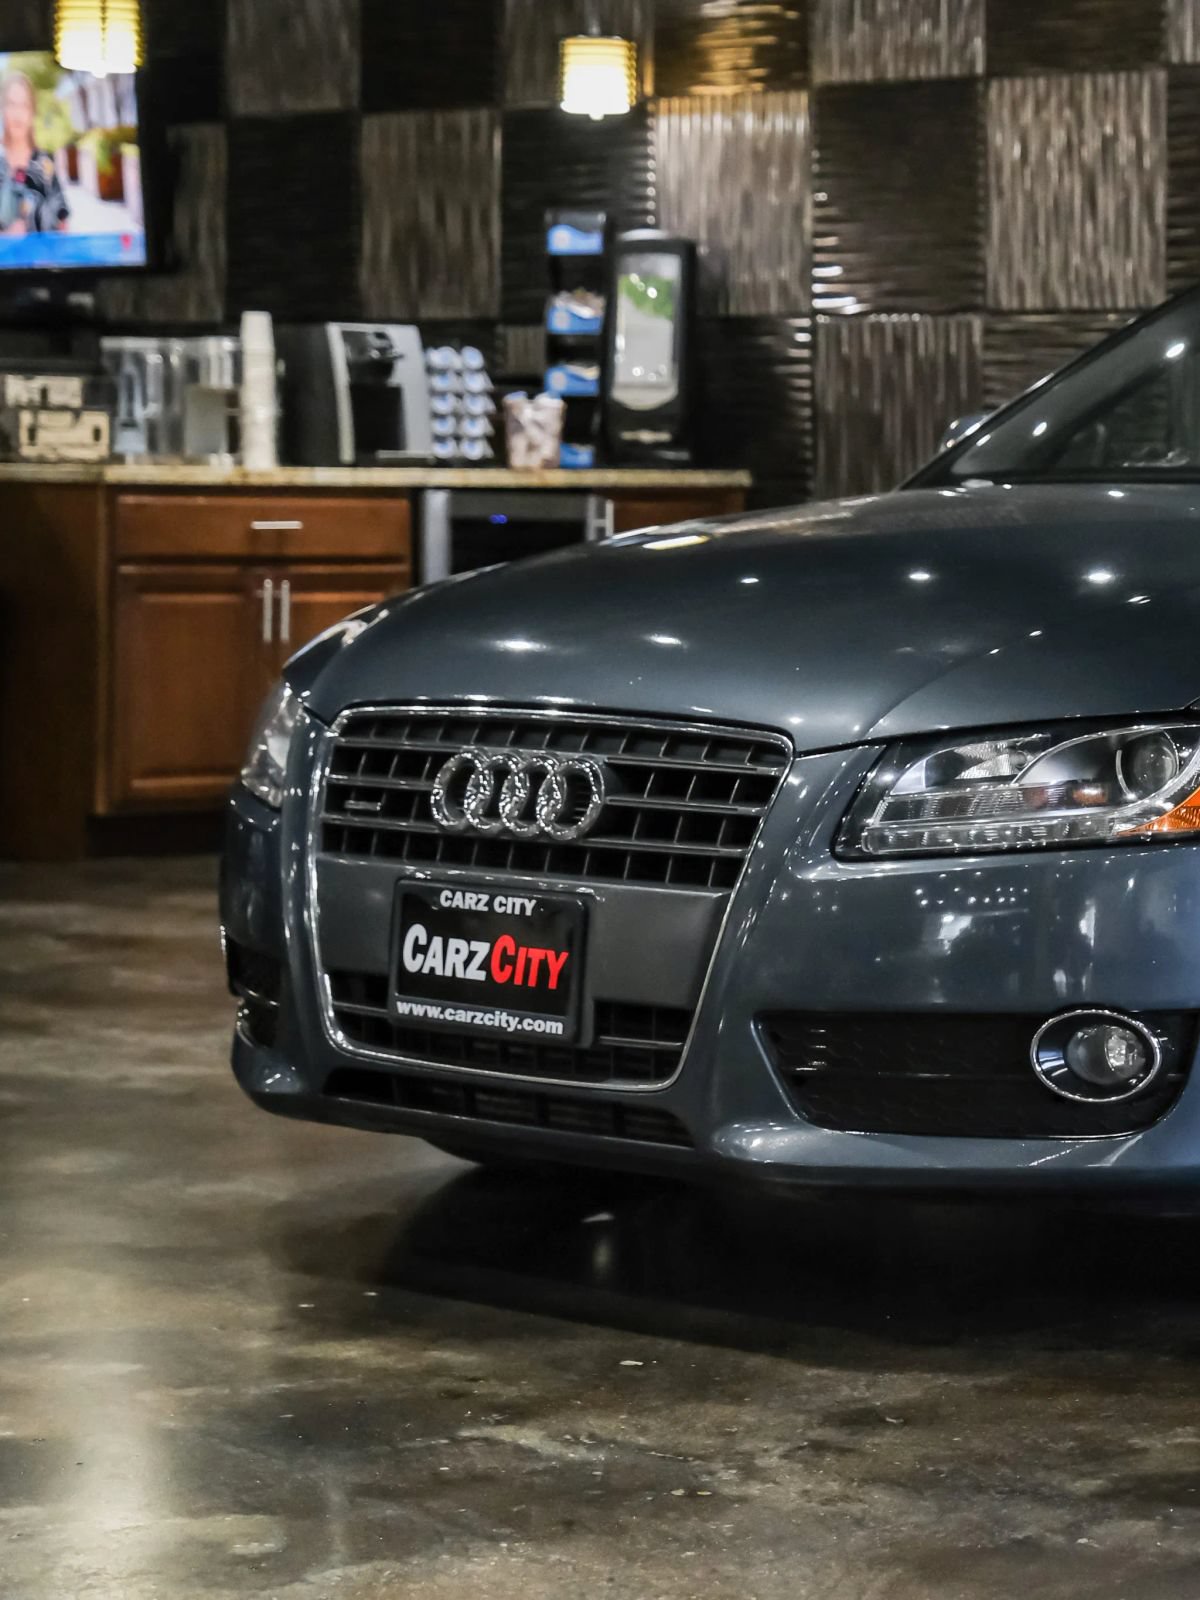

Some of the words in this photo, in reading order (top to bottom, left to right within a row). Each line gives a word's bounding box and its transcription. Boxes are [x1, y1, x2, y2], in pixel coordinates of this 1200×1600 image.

[439, 889, 490, 912] CARZ
[493, 895, 537, 916] CITY
[396, 1000, 564, 1035] www.carzcity.com
